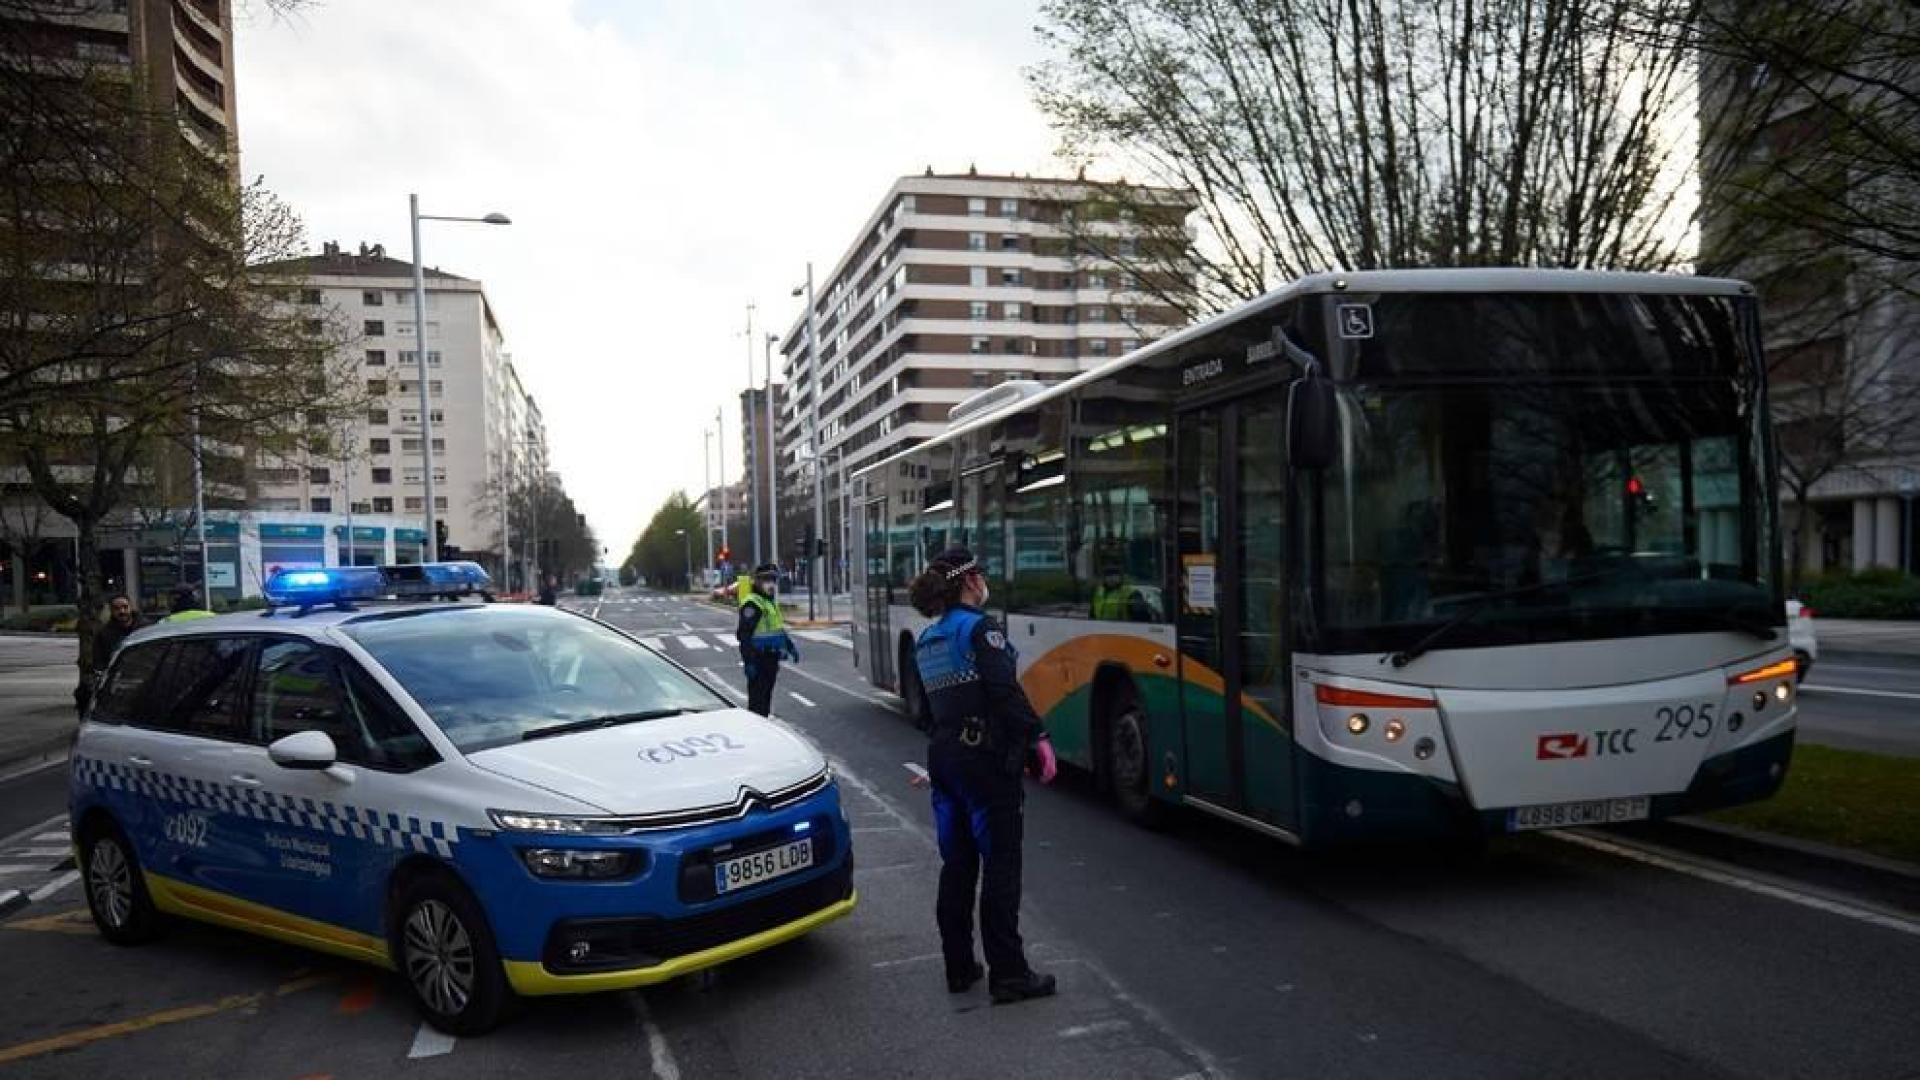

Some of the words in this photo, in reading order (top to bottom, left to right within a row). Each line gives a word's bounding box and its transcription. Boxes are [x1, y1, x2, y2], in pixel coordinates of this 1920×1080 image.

[1654, 703, 1716, 743] 295
[661, 732, 745, 757] 092
[1593, 728, 1638, 756] TCC
[177, 812, 209, 848] 092
[731, 852, 775, 883] 9856
[780, 842, 810, 869] LDB
